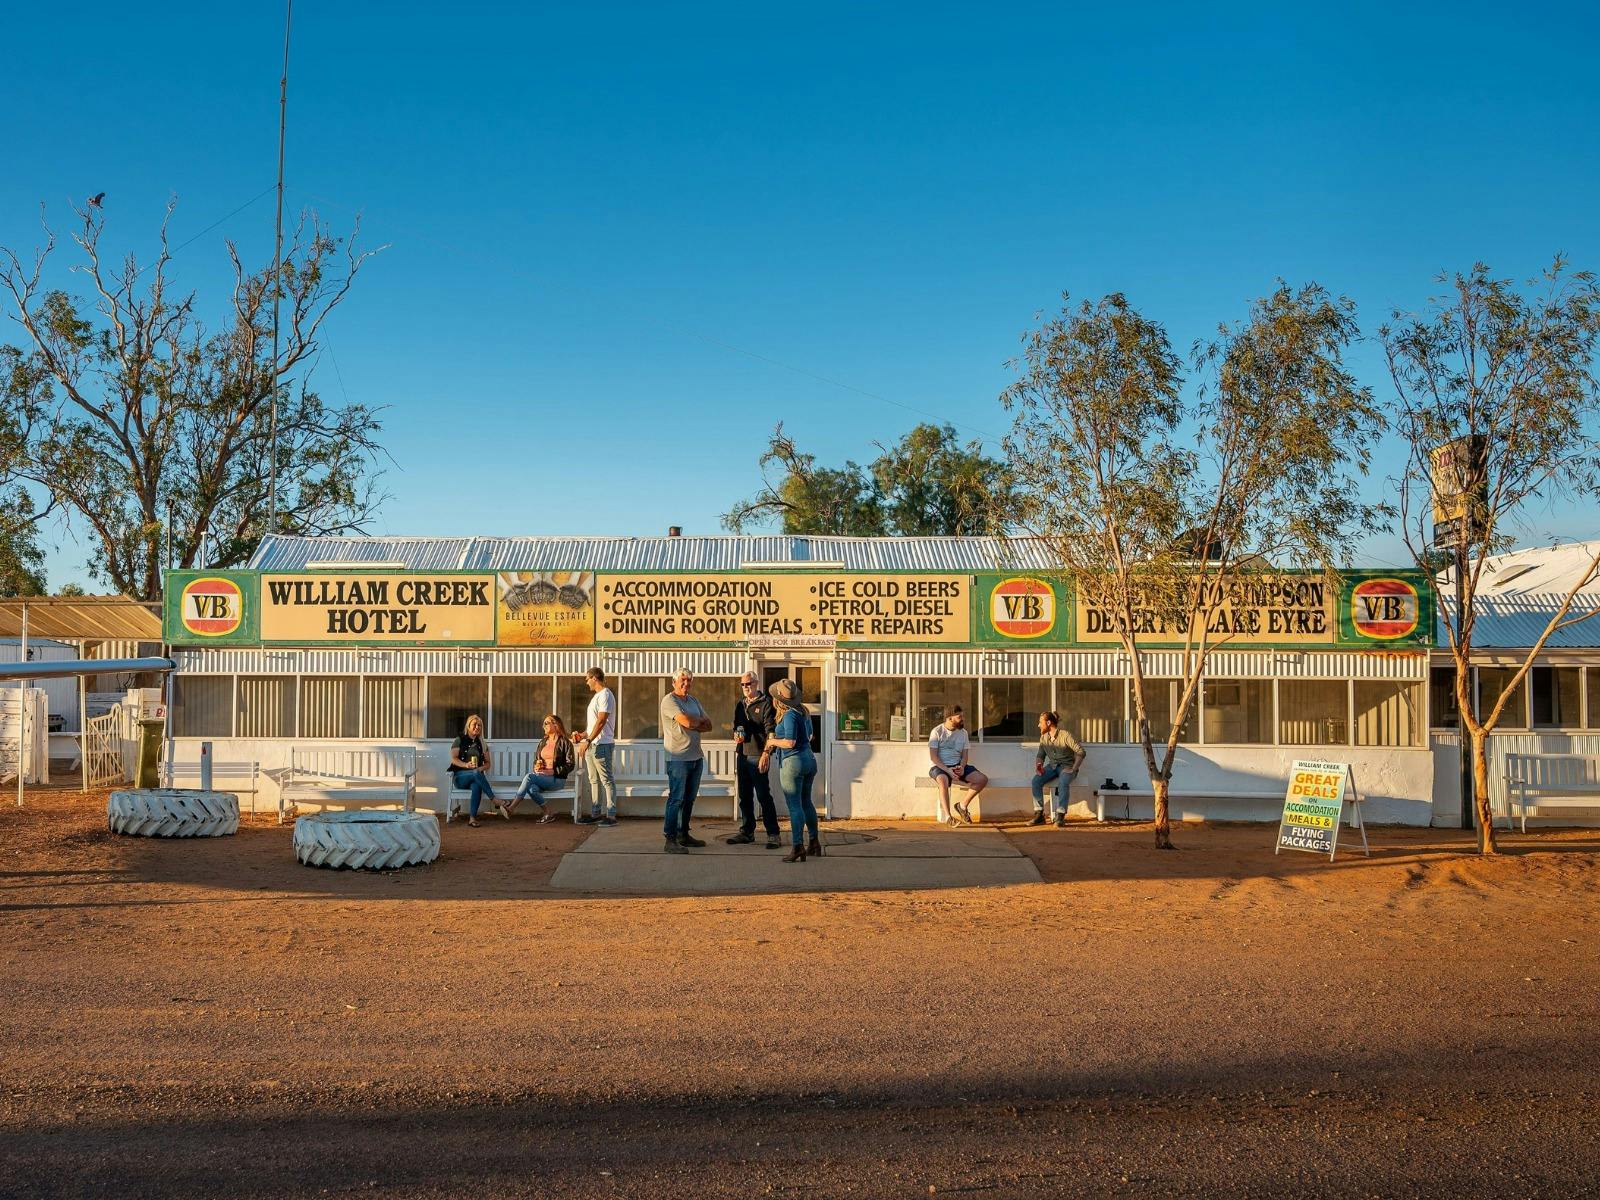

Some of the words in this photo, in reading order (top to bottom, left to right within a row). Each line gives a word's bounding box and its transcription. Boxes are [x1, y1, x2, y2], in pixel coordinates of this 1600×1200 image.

[268, 581, 390, 605] WILLIAM
[396, 581, 489, 606] CREEK
[613, 581, 772, 597] ACCOMMODATION
[819, 581, 845, 597] ICE
[852, 581, 900, 597] COLD
[906, 581, 960, 597] BEERS
[191, 595, 234, 619] VB
[612, 600, 696, 615] CAMPING
[703, 600, 780, 615] GROUND
[819, 600, 889, 618] PETROL,
[894, 600, 953, 616] DIESEL
[1001, 595, 1045, 620] VB
[1361, 596, 1406, 621] VB
[327, 609, 427, 634] HOTEL
[505, 612, 550, 621] BELLEVUE
[555, 612, 586, 621] ESTATE
[1268, 609, 1326, 633] EYRE
[612, 618, 675, 634] DINING
[681, 618, 736, 634] ROOM
[743, 618, 803, 634] MEALS
[819, 618, 865, 634] TYRE
[871, 618, 944, 634] REPAIRS
[1295, 773, 1340, 786] GREAT
[1292, 785, 1337, 798] DEALS
[1286, 803, 1339, 816] ACCOMODATION
[1288, 814, 1320, 826] MEALS
[1323, 818, 1331, 827] &
[1292, 827, 1325, 839] FLYING
[1281, 836, 1330, 850] PACKAGES
